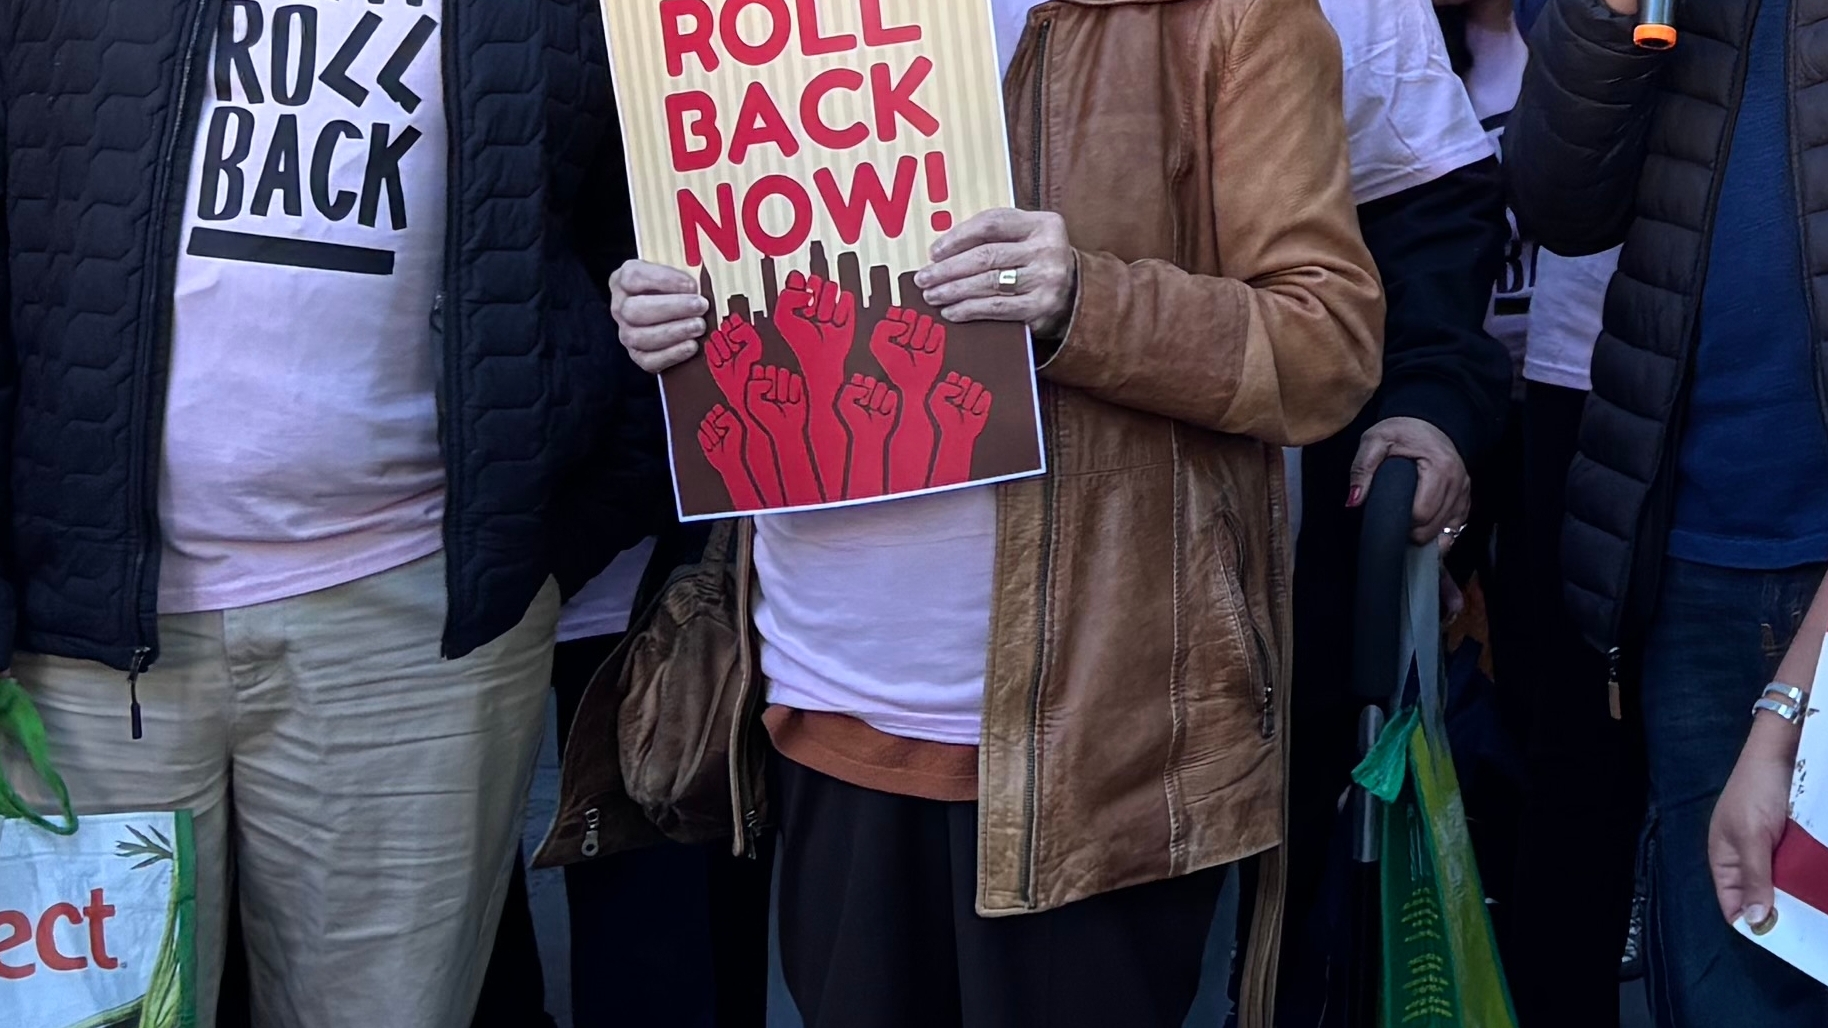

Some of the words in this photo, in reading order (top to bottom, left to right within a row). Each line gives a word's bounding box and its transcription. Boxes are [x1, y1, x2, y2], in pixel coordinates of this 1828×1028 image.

[197, 106, 422, 230] BACK
[664, 55, 940, 172] BACK
[676, 151, 953, 267] NOW!
